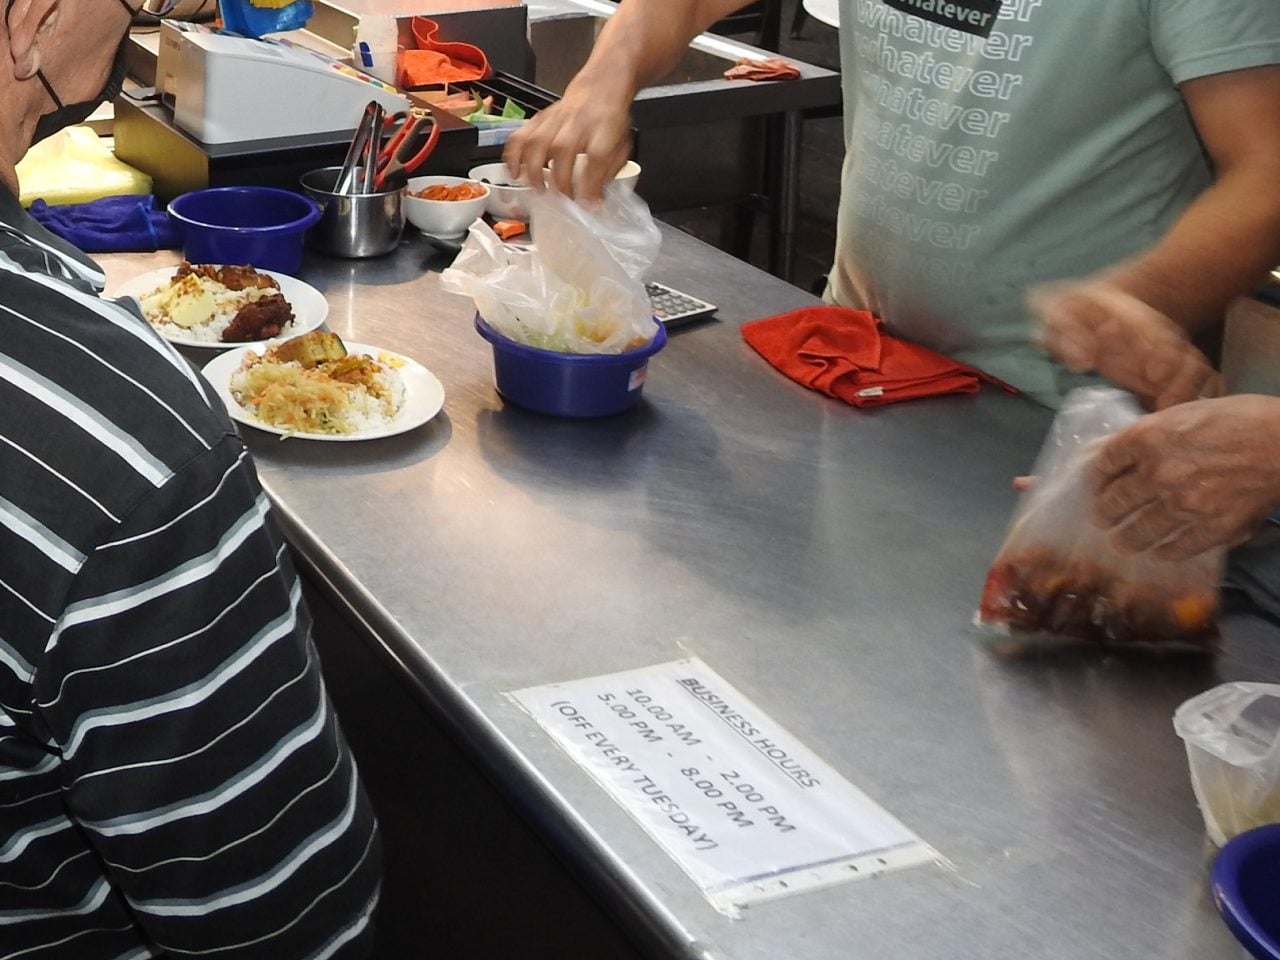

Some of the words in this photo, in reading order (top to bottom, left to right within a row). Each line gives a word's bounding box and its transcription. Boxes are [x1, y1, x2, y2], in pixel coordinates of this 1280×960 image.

[550, 700, 594, 730] (OFF
[585, 730, 641, 772] EVERY
[633, 774, 719, 851] TUESDAY)
[597, 692, 636, 720] 5.00
[629, 720, 664, 743] PM
[680, 767, 723, 799] 8.00
[716, 801, 755, 828] PM
[626, 688, 673, 722] 10.00
[665, 722, 702, 746] AM
[719, 770, 764, 803] 2.00
[757, 805, 797, 833] PM
[680, 677, 760, 737] BUSINESS
[754, 738, 821, 788] HOURS
